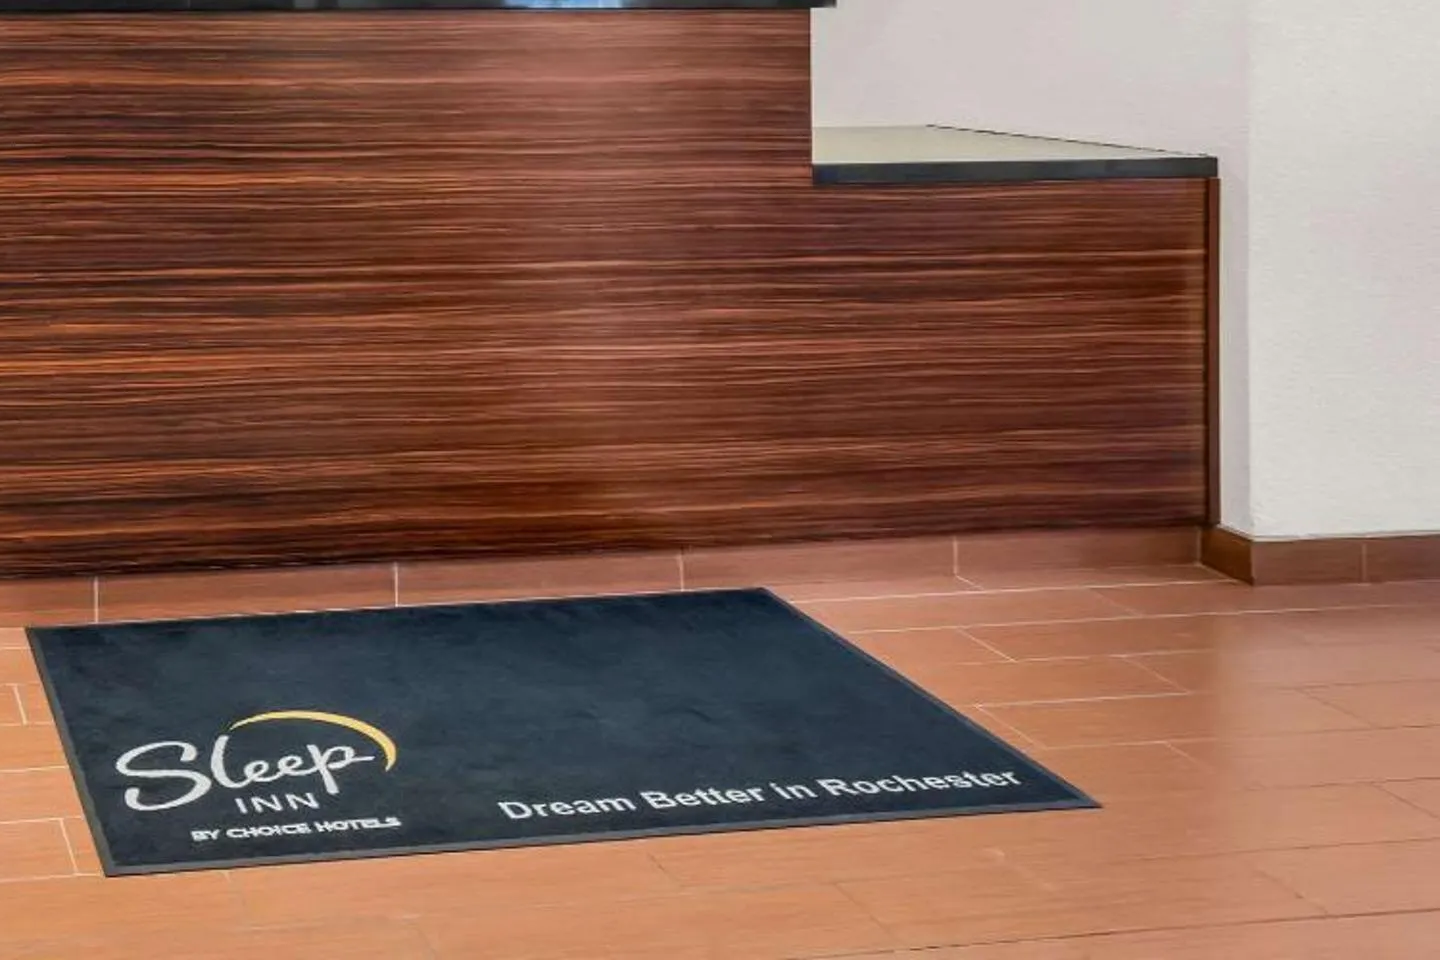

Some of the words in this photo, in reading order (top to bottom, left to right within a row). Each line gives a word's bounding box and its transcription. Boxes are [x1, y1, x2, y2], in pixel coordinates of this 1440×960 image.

[116, 735, 375, 811] Sleep
[234, 792, 320, 814] INN
[497, 797, 636, 819] Dream
[640, 787, 765, 809] Better
[770, 781, 816, 800] in
[817, 770, 1022, 796] Rochester
[190, 828, 221, 841] BY
[226, 821, 310, 839] CHOICE
[314, 816, 402, 833] HOTELS
